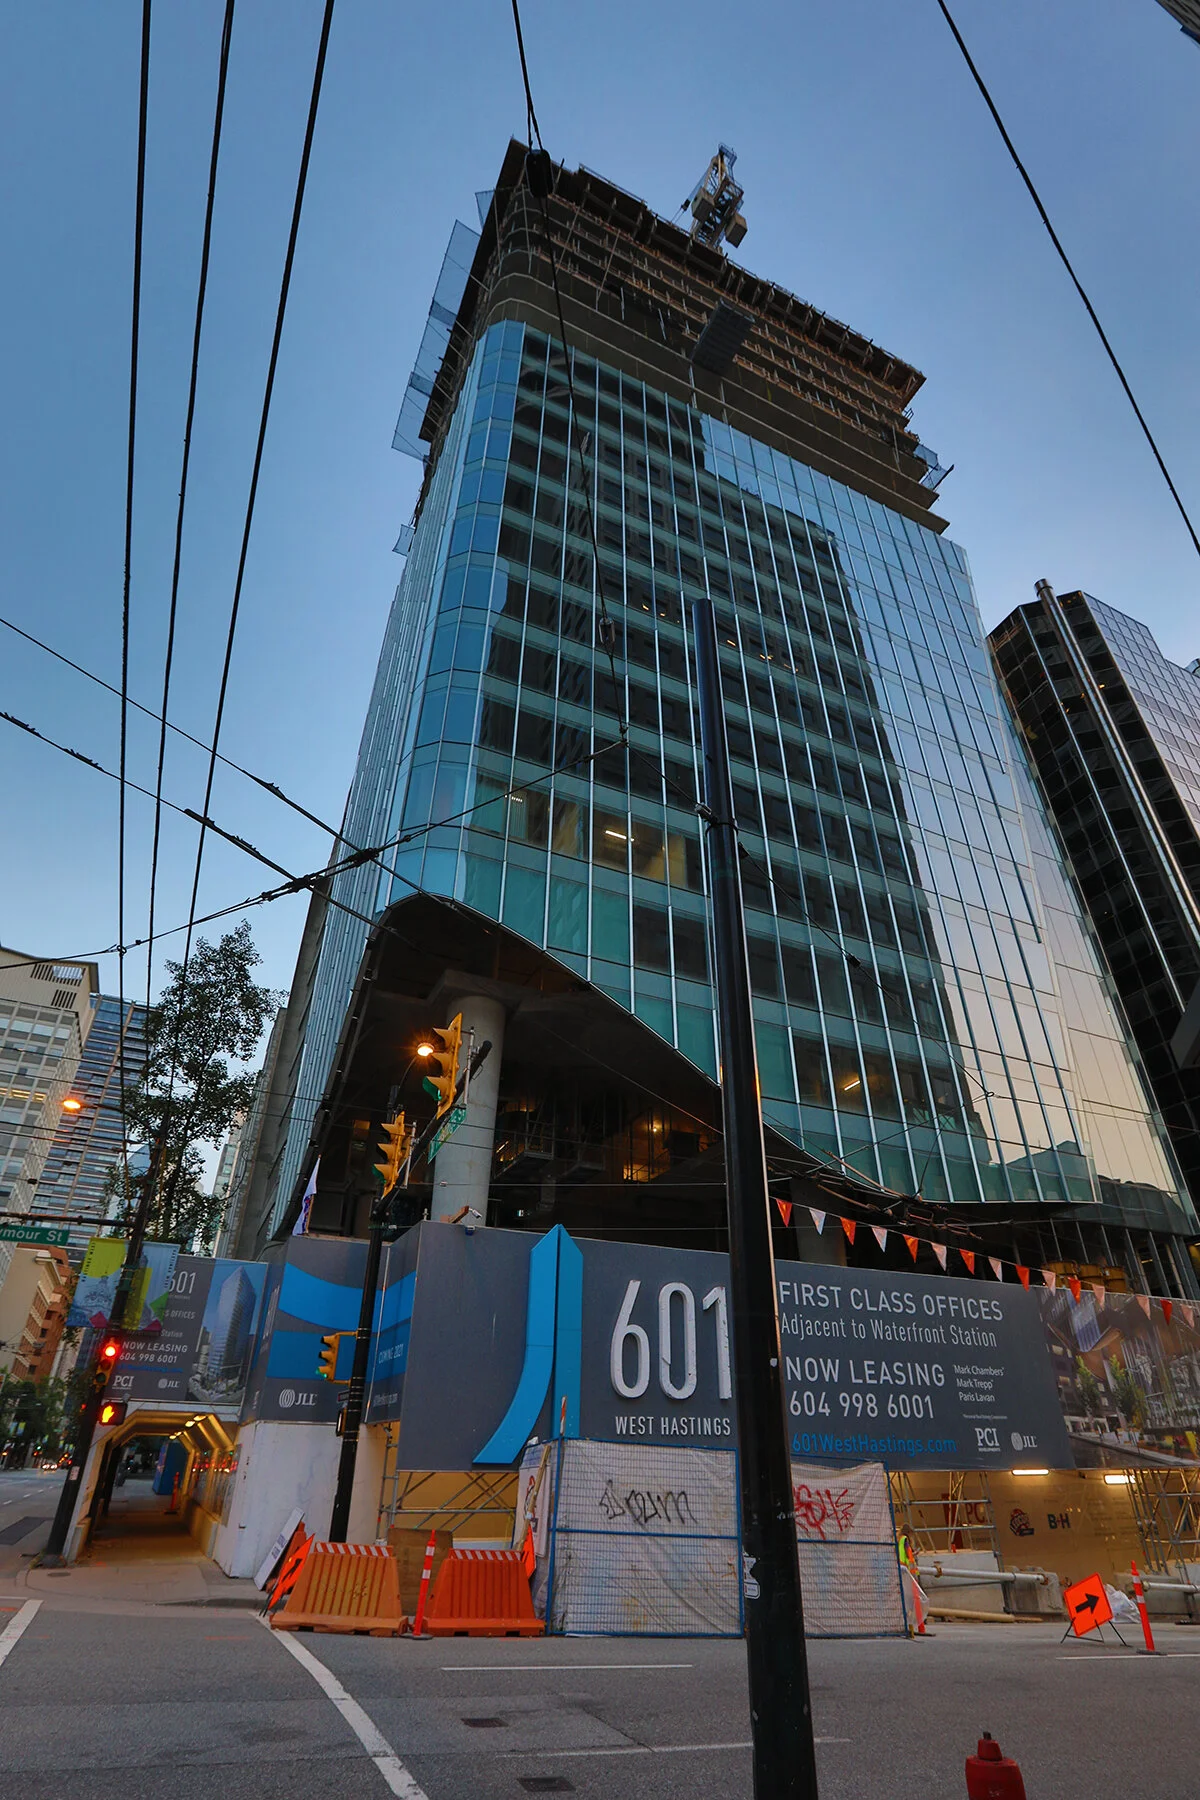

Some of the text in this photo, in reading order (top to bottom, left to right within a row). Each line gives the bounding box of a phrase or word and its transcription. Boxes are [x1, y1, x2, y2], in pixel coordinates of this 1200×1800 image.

[47, 1230, 62, 1241] St
[779, 1281, 1003, 1321] FIRST CLASS OFFICES
[781, 1312, 997, 1348] Adjacent to Waterfront Station
[611, 1280, 732, 1399] 601
[122, 1341, 188, 1353] NOW LEASING
[120, 1352, 177, 1363] 604 998 6001
[785, 1356, 945, 1387] NOW LEASING
[953, 1364, 971, 1375] Mark
[113, 1375, 134, 1387] PCI
[956, 1378, 974, 1388] Mark
[295, 1393, 317, 1406] JLL
[959, 1391, 975, 1401] Paris
[790, 1390, 934, 1419] 604 998 6001
[615, 1416, 731, 1436] WEST HASTINGS
[974, 1428, 1000, 1447] PCI
[1023, 1435, 1038, 1448] JLL
[792, 1432, 957, 1457] 601WestHastings.com
